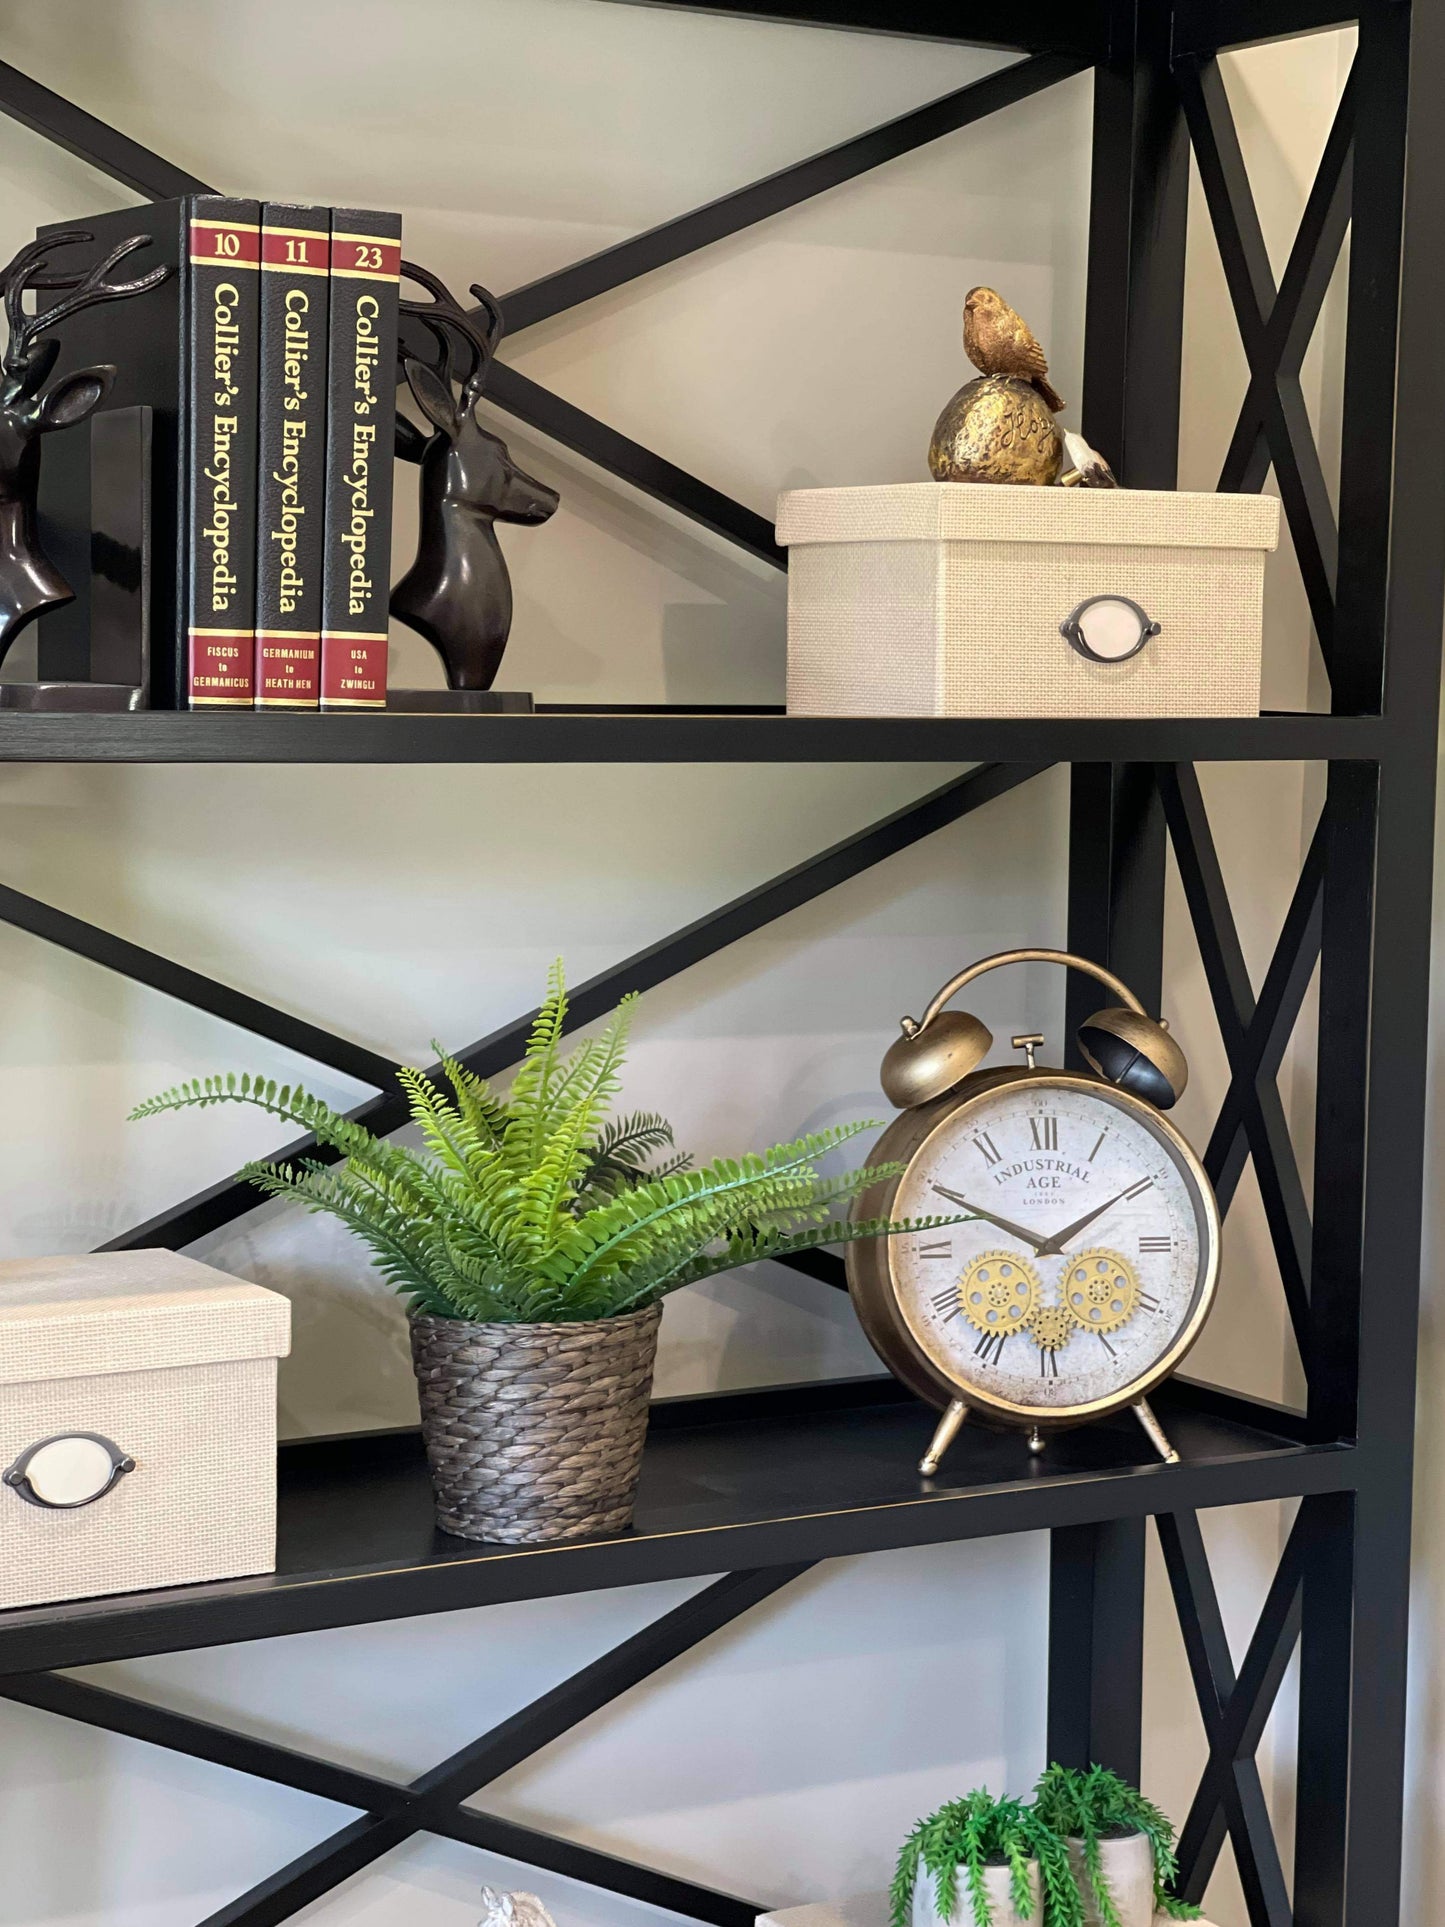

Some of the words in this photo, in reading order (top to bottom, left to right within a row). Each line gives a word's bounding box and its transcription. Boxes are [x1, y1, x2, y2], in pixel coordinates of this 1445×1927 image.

[214, 233, 240, 256] 10
[285, 241, 309, 263] 11
[355, 246, 383, 269] 23
[214, 283, 239, 406] Collier's
[284, 289, 309, 411] Collier's
[354, 295, 379, 415] Collier's
[203, 414, 238, 612] Encyclopedia
[271, 419, 306, 614] Encyclopedia
[341, 423, 376, 615] Encyclopedia
[207, 646, 239, 658] FISCUS
[263, 648, 315, 660] GERMANIUM
[350, 650, 367, 660] USA
[218, 662, 227, 672] to
[285, 664, 294, 674] to
[354, 665, 363, 674] to
[193, 676, 249, 688] GERMANICUS
[265, 678, 294, 689] HEATH
[296, 679, 312, 690] HEN
[340, 679, 375, 690] ZWINGLI
[1029, 1117, 1059, 1151] XII
[972, 1132, 1003, 1169] XI
[1087, 1132, 1107, 1163] I
[993, 1159, 1091, 1186] INDUSTRIAL
[1026, 1176, 1062, 1189] AGE
[919, 1239, 952, 1259] IX
[1139, 1236, 1171, 1252] III
